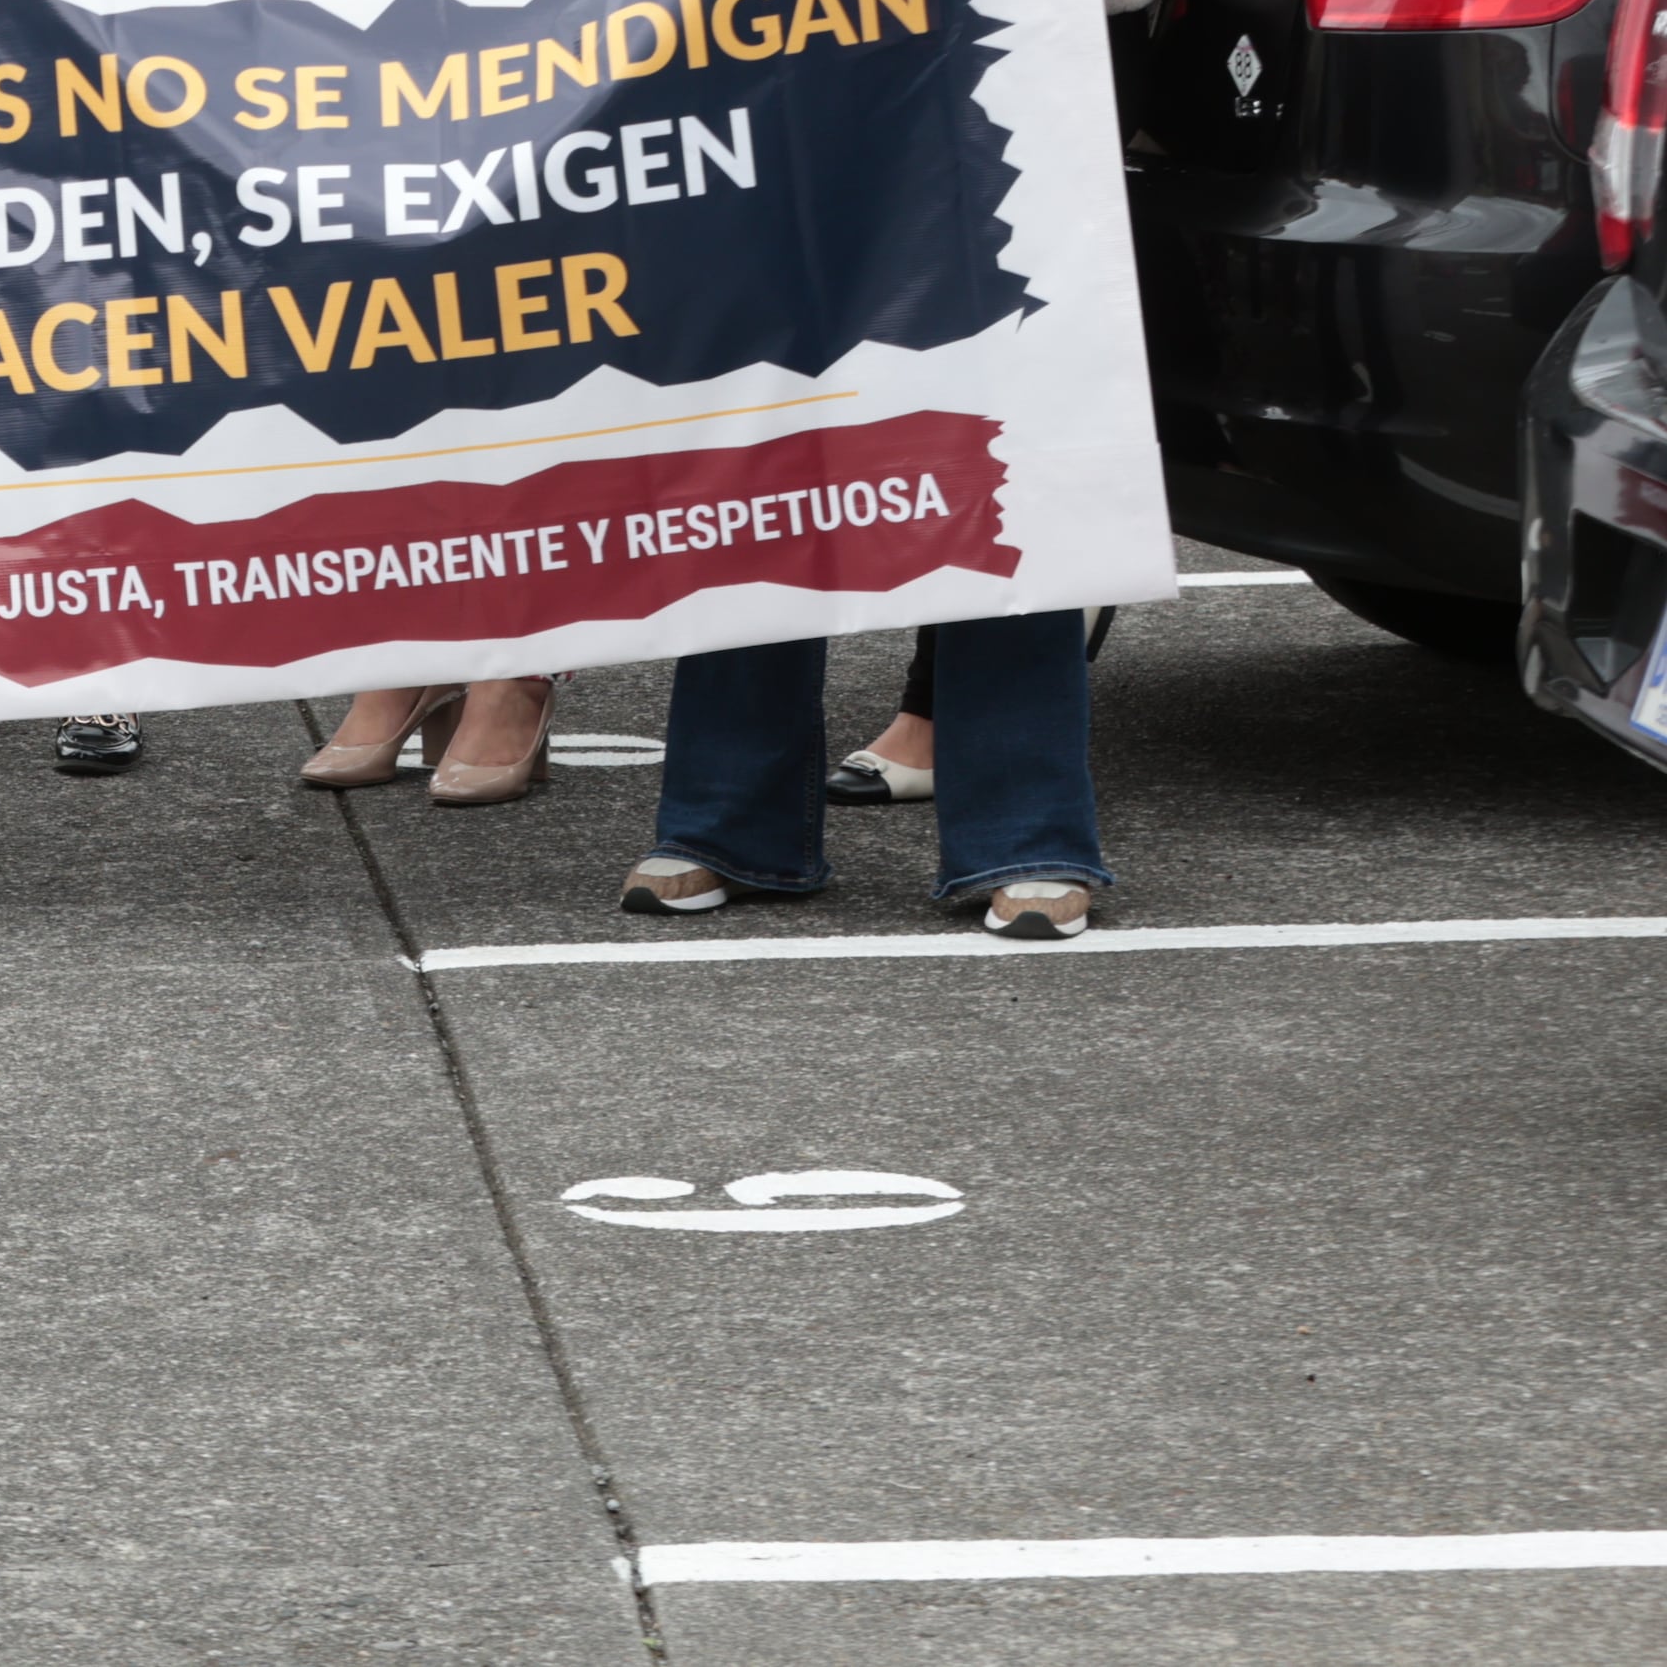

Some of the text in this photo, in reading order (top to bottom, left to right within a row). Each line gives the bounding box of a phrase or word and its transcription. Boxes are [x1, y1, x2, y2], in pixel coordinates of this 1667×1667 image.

[56, 56, 206, 136] NO
[238, 68, 347, 128] SE
[238, 166, 353, 246] SE
[383, 108, 756, 236] EXIGEN
[268, 253, 639, 372] VALER
[175, 526, 567, 606] TRANSPARENTE
[579, 519, 608, 563] Y
[626, 474, 949, 558] RESPETUOSA
